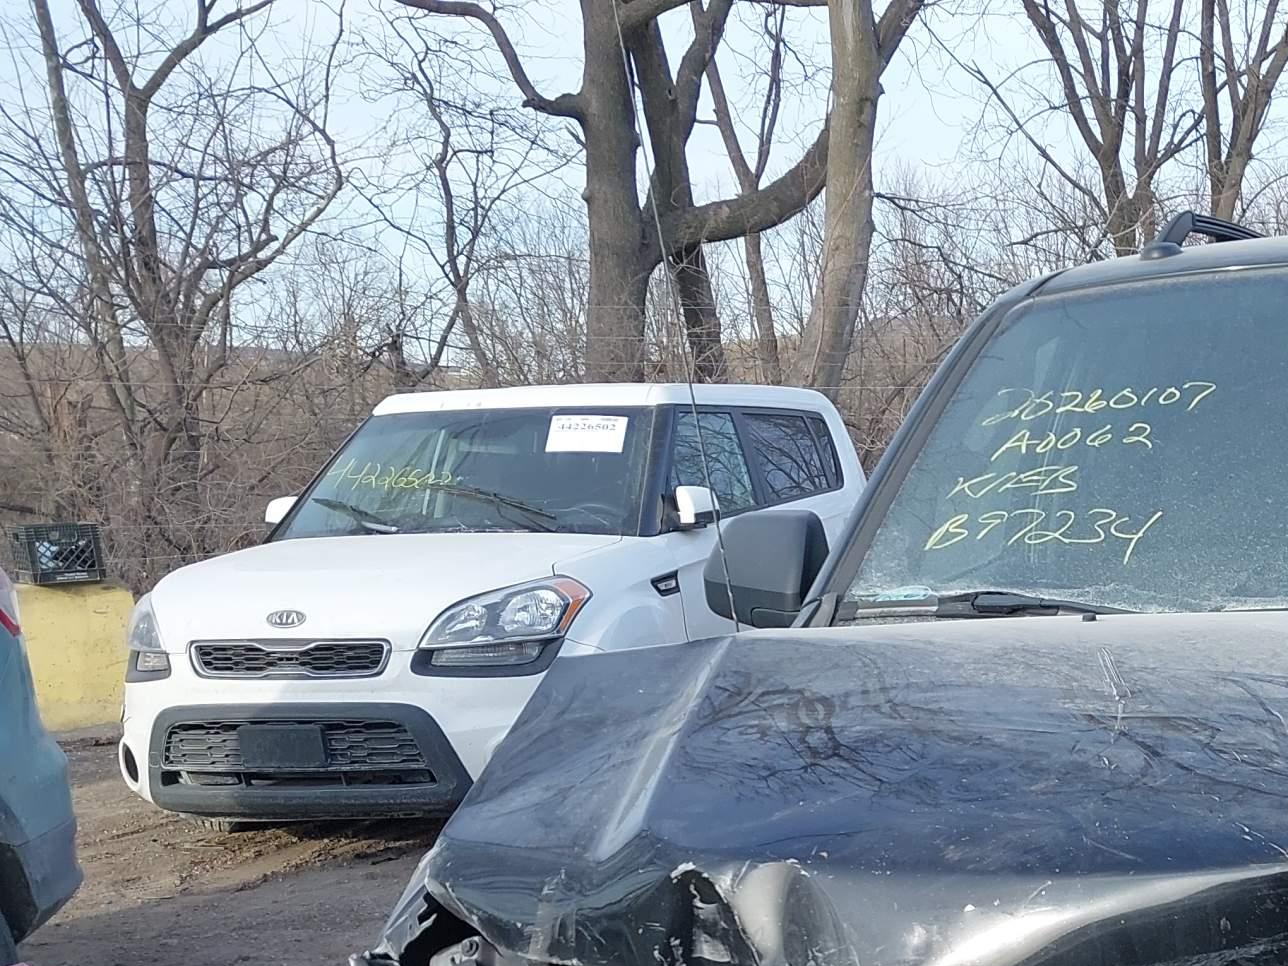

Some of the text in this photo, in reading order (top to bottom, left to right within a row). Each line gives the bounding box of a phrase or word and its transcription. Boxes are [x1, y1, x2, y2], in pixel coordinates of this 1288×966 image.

[990, 422, 1153, 462] A0062
[924, 508, 1164, 565] B97234
[271, 611, 299, 624] KIA
